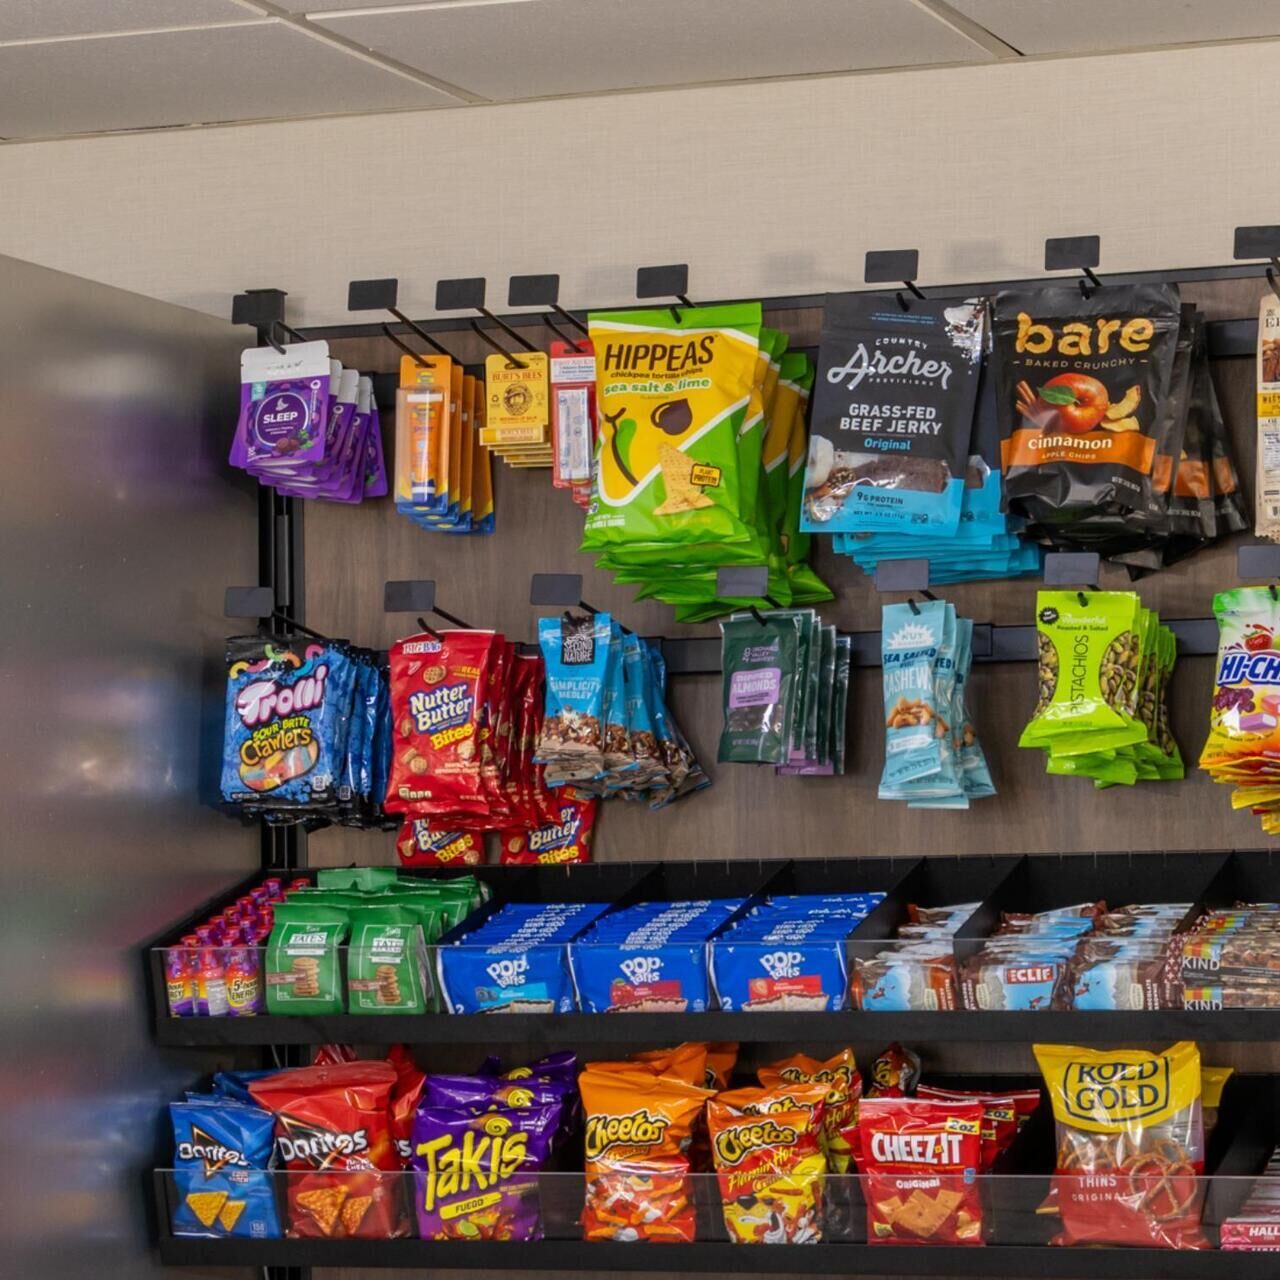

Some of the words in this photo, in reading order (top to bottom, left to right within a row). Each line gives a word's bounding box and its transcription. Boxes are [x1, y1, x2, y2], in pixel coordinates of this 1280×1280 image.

[1015, 312, 1154, 356] bare
[876, 336, 929, 350] COUNTRY
[604, 336, 714, 372] HIPPEAS
[827, 343, 953, 390] Archer
[1025, 359, 1069, 369] BAKED
[1074, 358, 1136, 370] CRUNCHY
[492, 372, 520, 381] BURT'S
[522, 371, 543, 380] BEES
[610, 370, 650, 380] chickpea
[651, 369, 680, 379] tortilla
[681, 366, 704, 379] chips
[869, 377, 934, 386] PROVISIONS
[605, 383, 628, 395] sea
[631, 380, 662, 393] salt
[665, 381, 675, 392] &
[677, 376, 711, 390] lime
[263, 411, 298, 424] SLEEP
[849, 403, 936, 419] GRASS-FED
[840, 418, 882, 432] BEEF
[886, 419, 942, 435] JERKY
[864, 438, 911, 452] Original
[1028, 434, 1113, 450] cinnamon
[1061, 612, 1106, 625] Wonderful
[564, 639, 594, 651] SECOND
[564, 651, 593, 663] NATURE
[884, 652, 901, 664] SEA
[903, 647, 937, 661] SALTED
[1071, 634, 1089, 715] PISTACHIOS
[550, 680, 602, 692] SIMPLICITY
[559, 690, 593, 699] MEDLEY
[237, 664, 328, 726] Trolli
[410, 684, 467, 714] Nutter
[416, 698, 472, 731] Butter
[253, 723, 279, 741] SOUR
[282, 716, 310, 730] BRITE
[430, 723, 474, 750] Bites
[240, 728, 312, 765] Crawlers
[1182, 956, 1220, 971] KIND
[1017, 967, 1051, 981] CLIF
[1077, 1061, 1159, 1084] ROLD
[1075, 1084, 1160, 1112] GOLD
[586, 1111, 668, 1159] Cheetos
[716, 1121, 797, 1164] Cheetos
[278, 1130, 368, 1161] Doritos
[872, 1132, 963, 1165] CHEEZ-IT
[179, 1143, 249, 1166] Doritos
[1078, 1175, 1117, 1188] THINS
[1072, 1191, 1127, 1201] ORIGINAL
[455, 1197, 485, 1213] FUEGO
